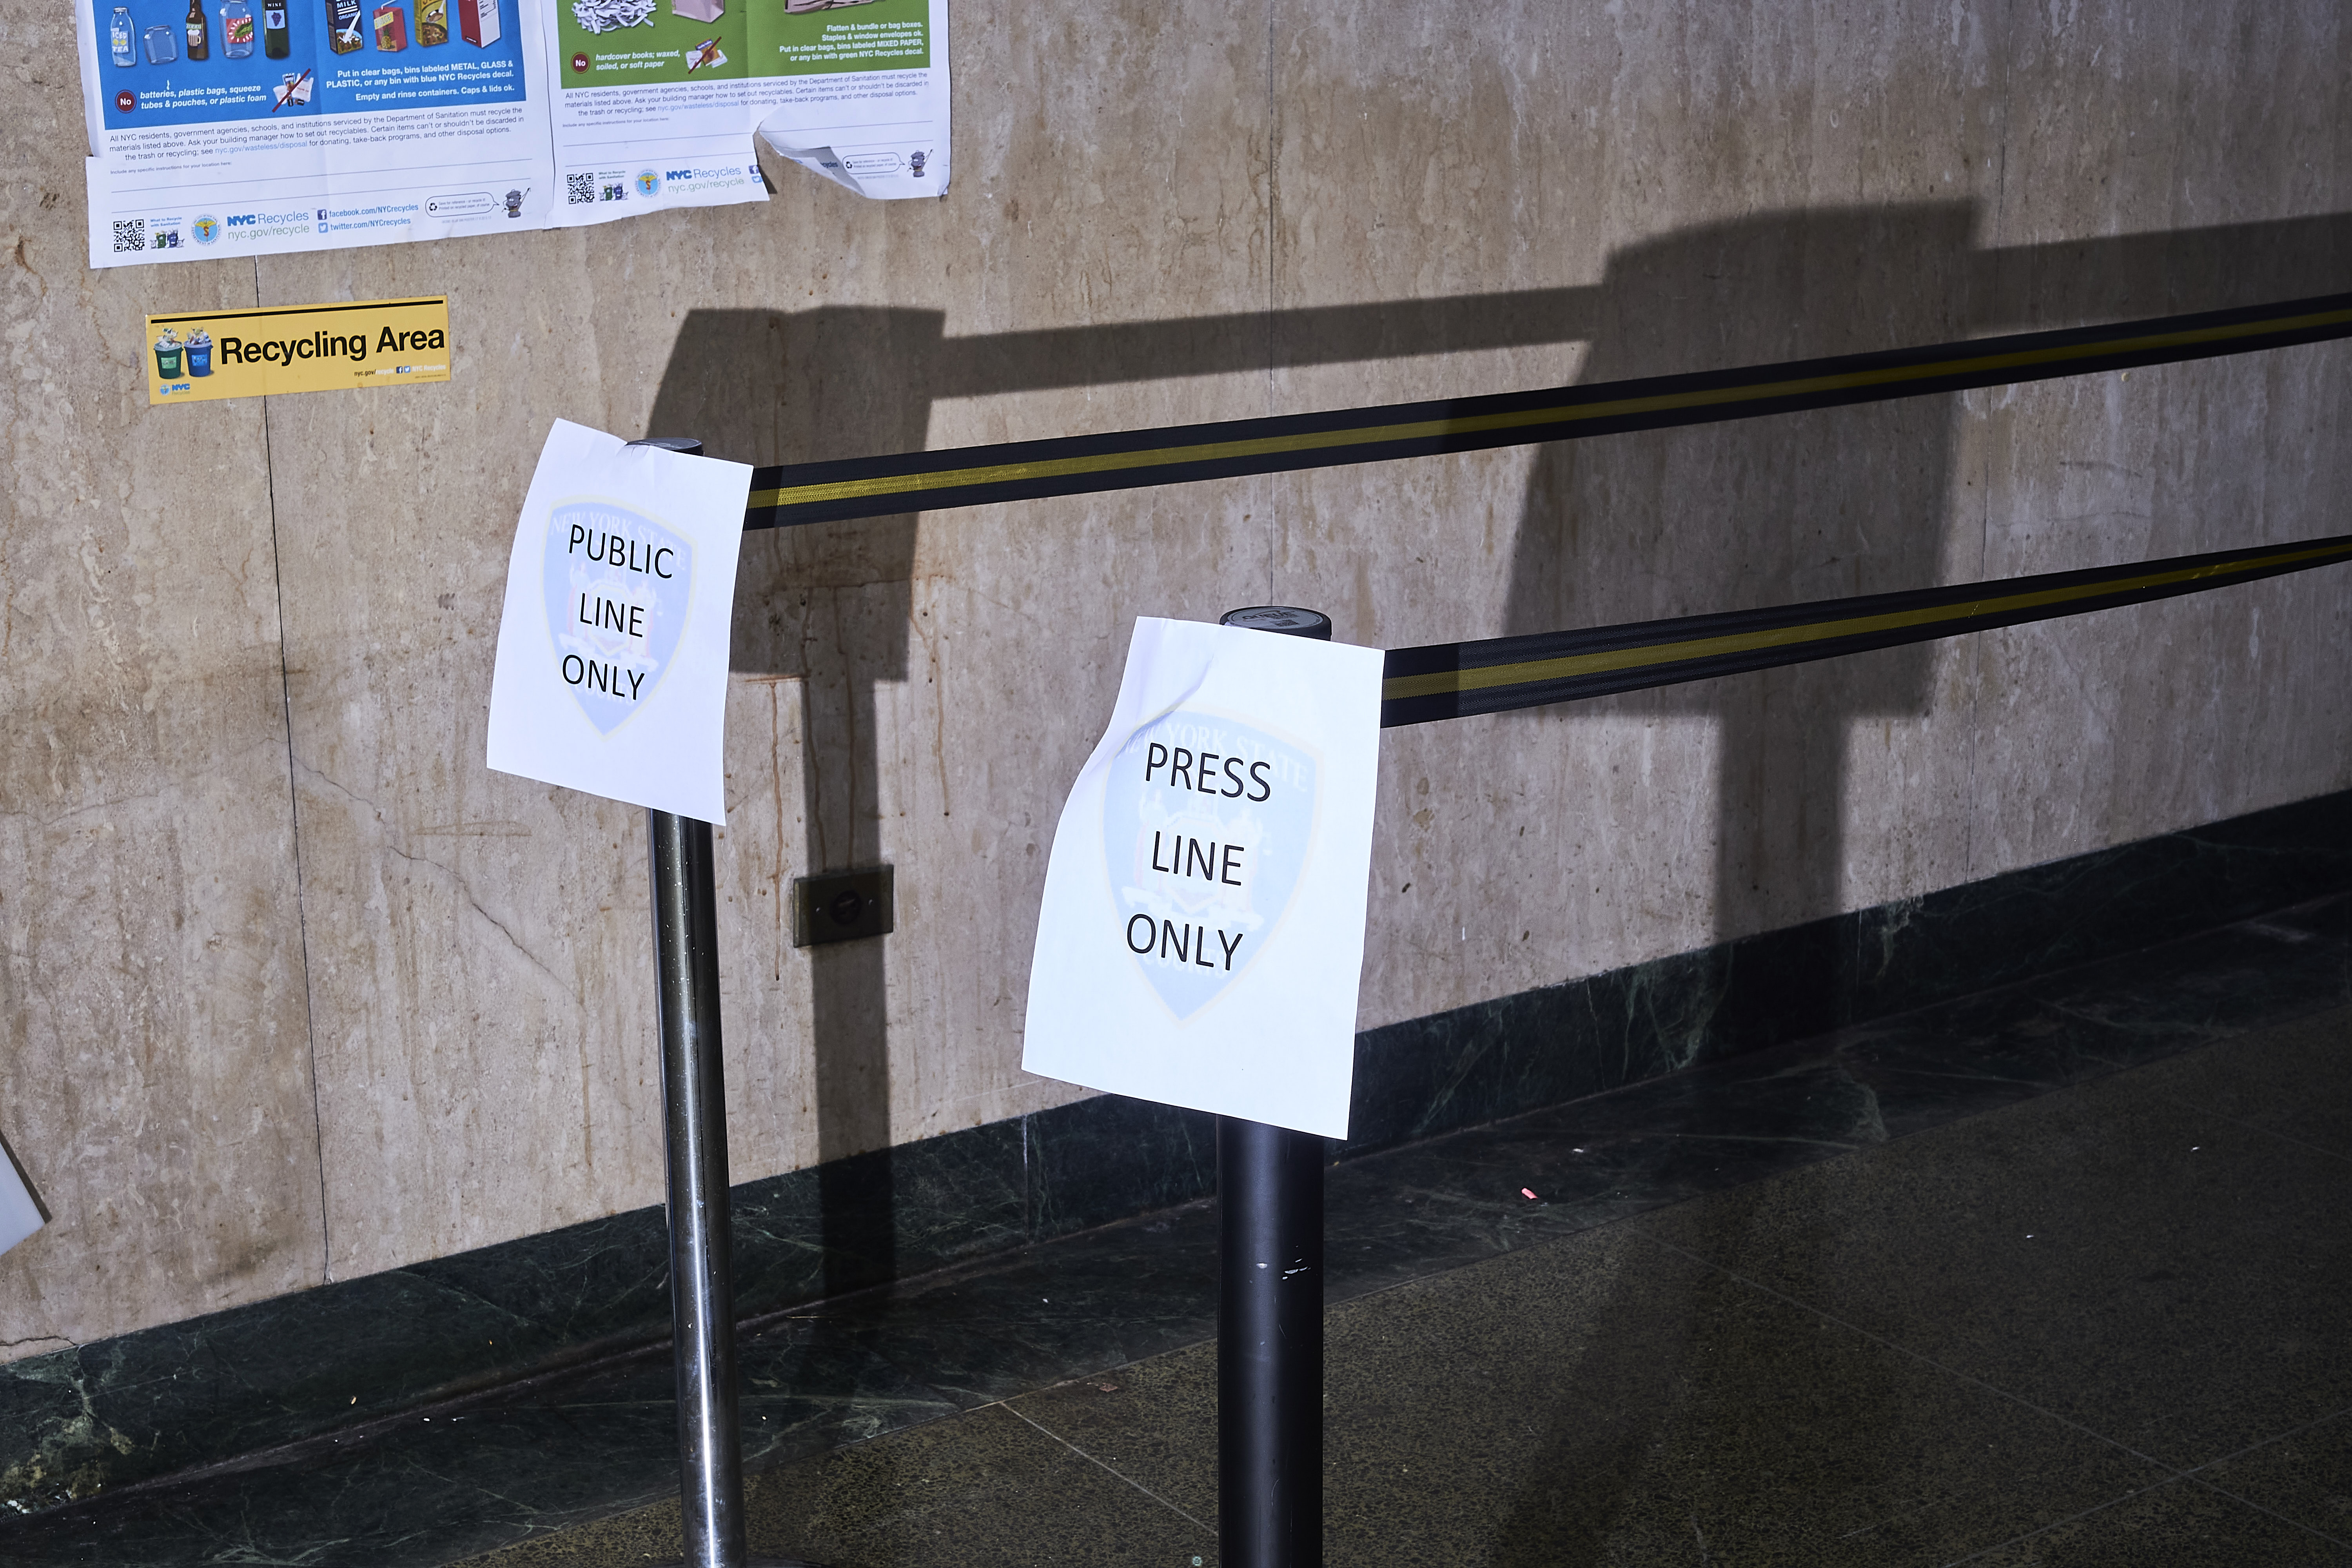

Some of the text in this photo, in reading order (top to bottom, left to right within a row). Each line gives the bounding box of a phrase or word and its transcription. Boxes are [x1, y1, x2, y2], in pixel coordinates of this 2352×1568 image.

[337, 0, 356, 8] MILK
[875, 49, 903, 57] Recycles
[422, 64, 449, 72] labeled
[451, 62, 479, 71] METAL,
[481, 60, 506, 69] GLASS
[326, 79, 362, 88] PLASTIC,
[457, 72, 490, 80] Recycles
[140, 85, 261, 99] batteries, plastic bags, squeeze
[356, 93, 379, 101] Empty
[418, 88, 459, 97] containers.
[172, 98, 207, 108] pouches,
[220, 95, 245, 105] plastic
[139, 132, 171, 140] residents,
[174, 129, 214, 139] government
[217, 126, 249, 135] agencies,
[387, 114, 425, 123] Department
[488, 108, 510, 116] recycle
[109, 143, 141, 152] materials
[329, 127, 368, 136] recyclables.
[666, 166, 741, 181] NYC Recycles
[668, 177, 744, 194] nyc.gov/recycle
[227, 211, 309, 226] NYC Recycles
[329, 204, 419, 218] facebook.com/NYCrecycles
[228, 224, 310, 241] nyc.gov/recycle
[330, 218, 411, 231] twitter.com/NYCrecycles
[220, 326, 445, 367] Recycling Area
[589, 512, 632, 541] YORK
[569, 524, 673, 579] PUBLIC
[580, 593, 644, 638] LINE
[562, 654, 645, 701] ONLY
[1166, 722, 1228, 755] YORK
[1145, 742, 1271, 802] PRESS
[1152, 831, 1244, 886] LINE
[1126, 913, 1243, 971] ONLY
